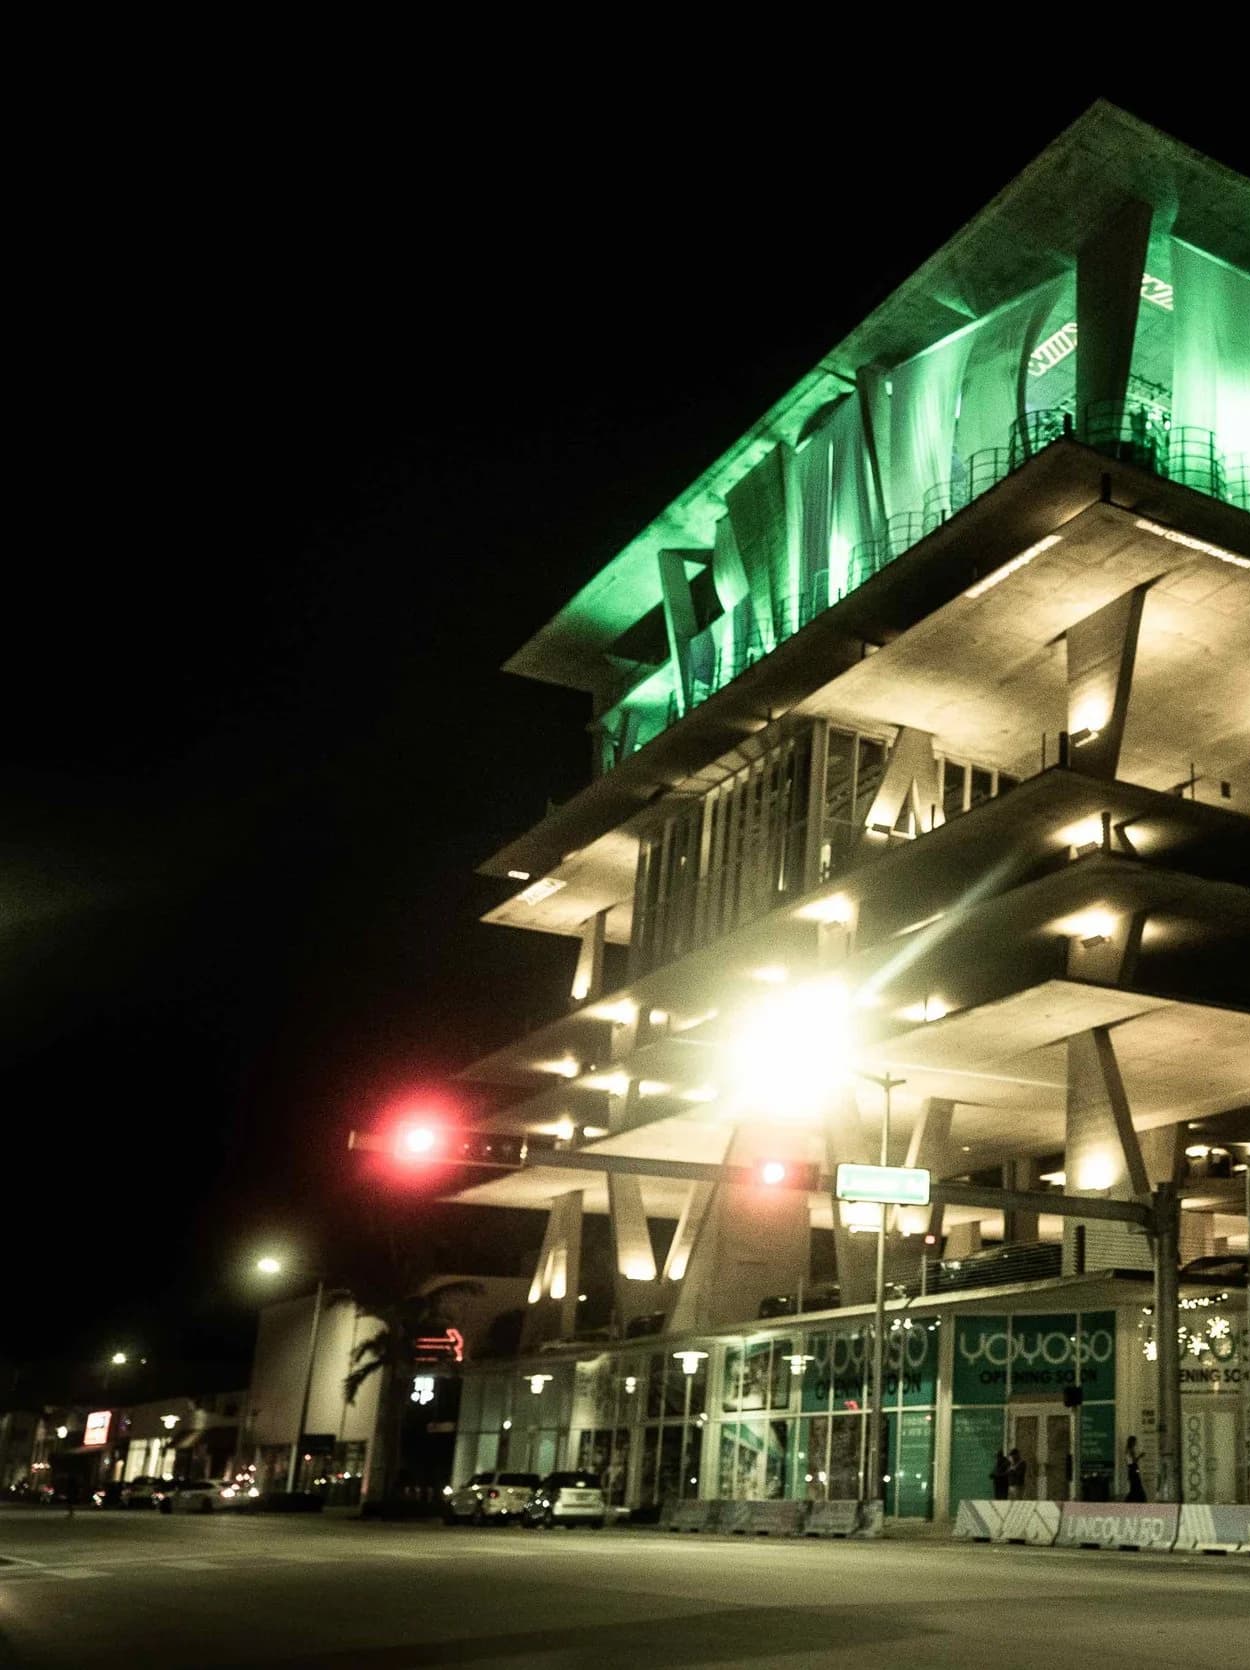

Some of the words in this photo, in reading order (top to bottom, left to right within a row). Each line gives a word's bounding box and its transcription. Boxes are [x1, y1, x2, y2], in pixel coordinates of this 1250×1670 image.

[960, 1330, 1113, 1366] YOYOSO
[1179, 1368, 1221, 1383] ENING
[1067, 1516, 1140, 1540] LINCOLN
